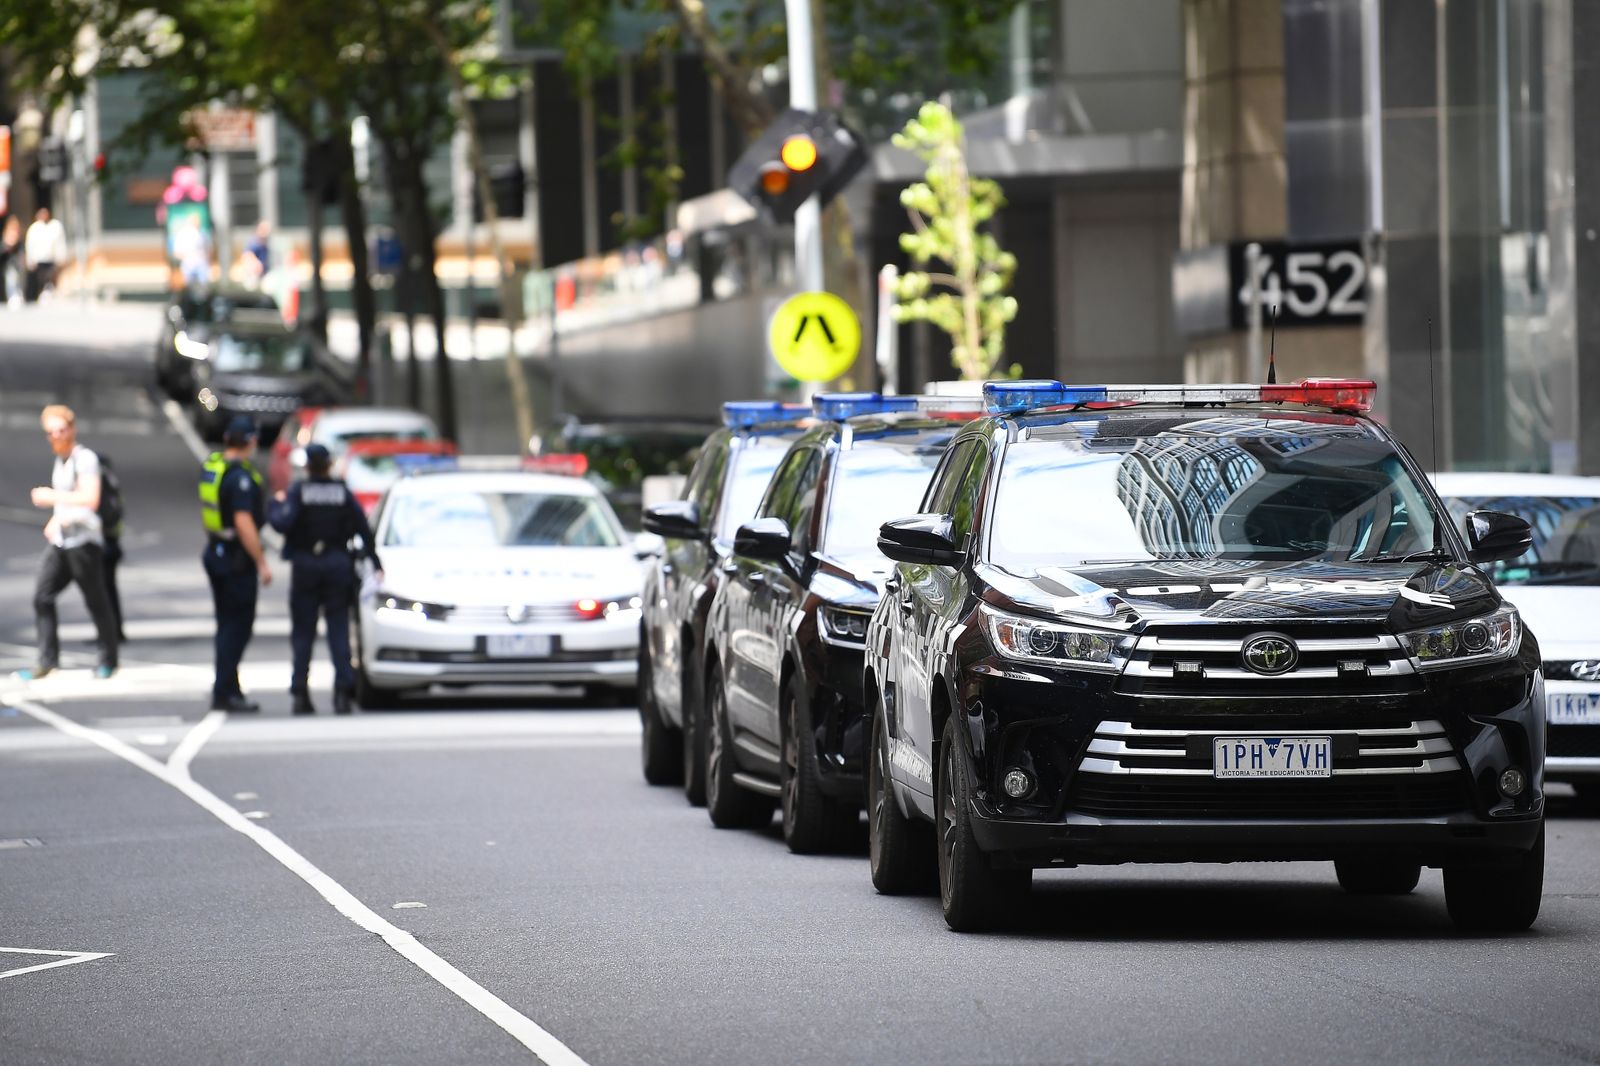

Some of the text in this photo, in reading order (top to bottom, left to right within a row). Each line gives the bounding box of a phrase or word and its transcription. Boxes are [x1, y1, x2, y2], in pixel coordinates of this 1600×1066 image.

[1238, 251, 1367, 316] 452
[1556, 698, 1587, 716] 1KH
[1221, 744, 1327, 769] 1PH 7VH
